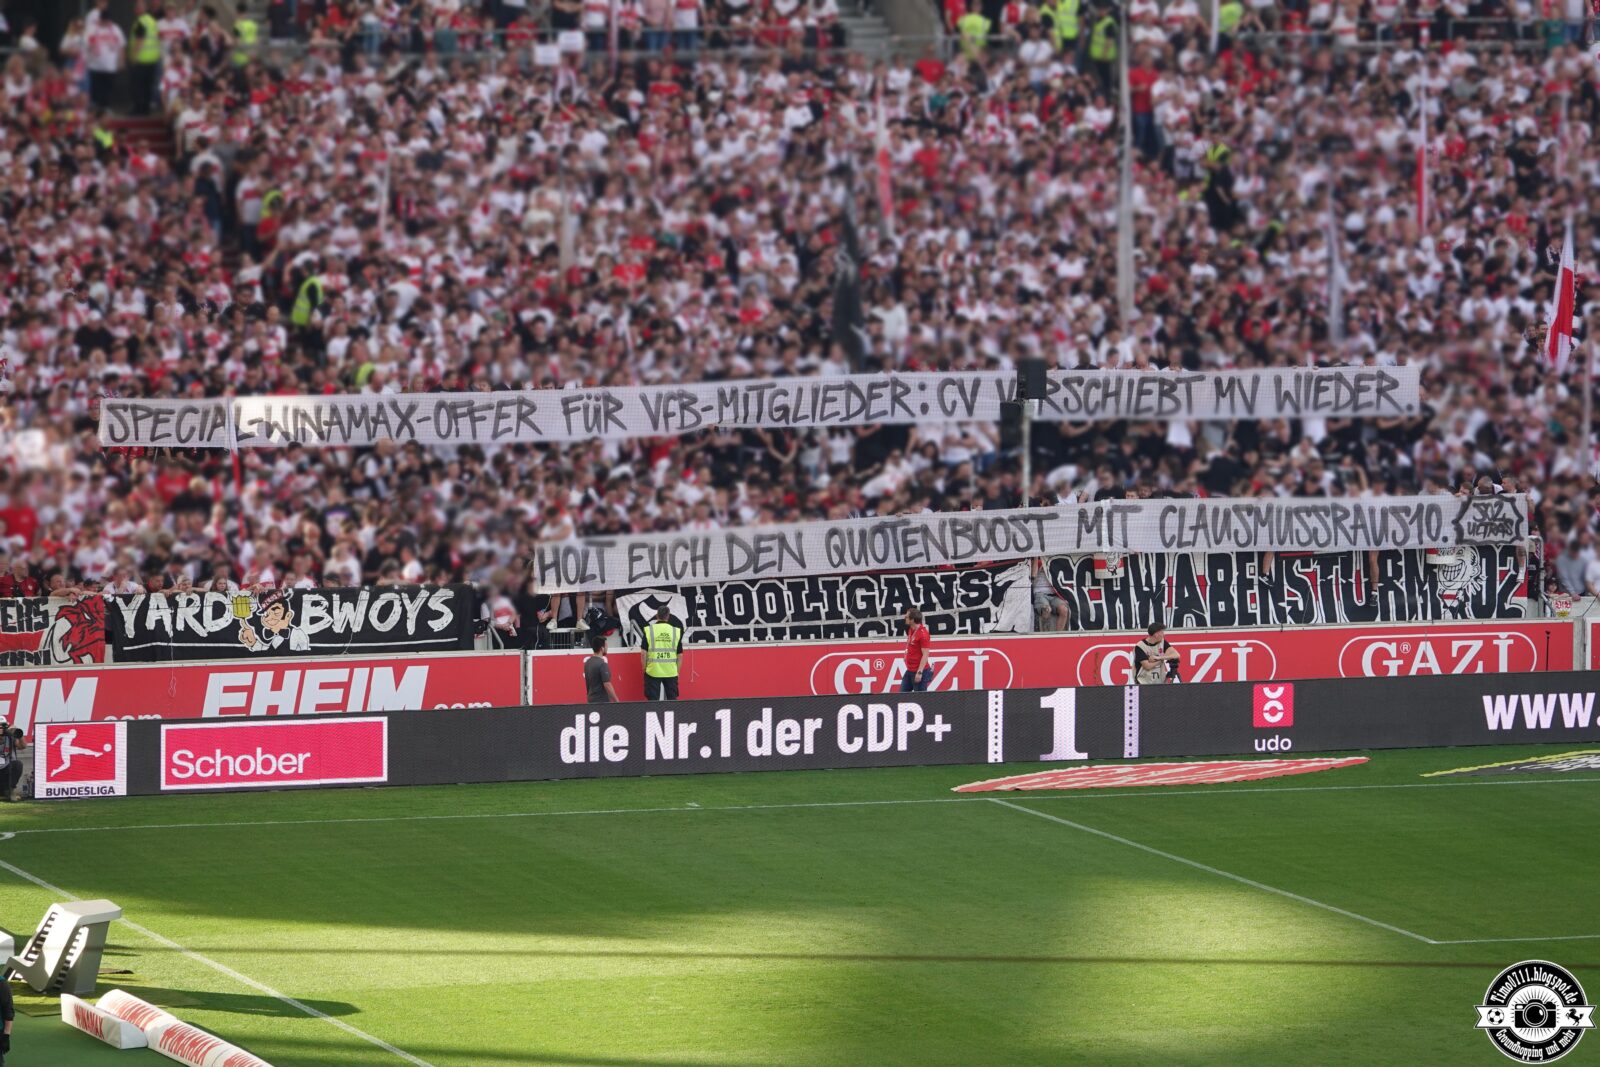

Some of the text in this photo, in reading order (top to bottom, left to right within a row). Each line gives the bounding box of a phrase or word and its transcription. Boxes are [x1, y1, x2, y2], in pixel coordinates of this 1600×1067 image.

[561, 391, 628, 435] FÜR
[937, 377, 981, 418] CV
[995, 374, 1206, 416] VRSCHIEBT
[1214, 374, 1261, 415] MV
[1274, 370, 1415, 413] WIEDER.
[538, 539, 616, 588] HOLT
[627, 536, 711, 582] EUCH
[726, 531, 806, 577] DEN
[825, 512, 1059, 568] QUOTENBOOST
[1076, 503, 1143, 549] MIT
[115, 588, 455, 638] YARD BWOYS
[680, 569, 998, 629] HOOLIGANS
[202, 665, 429, 718] EHEIM
[559, 712, 629, 764] die
[746, 707, 823, 757] der
[836, 702, 952, 753] CDP+
[1039, 688, 1088, 760] 1
[1254, 734, 1292, 751] udo
[171, 746, 311, 779] Schober
[46, 786, 115, 797] BUNDESLIGA
